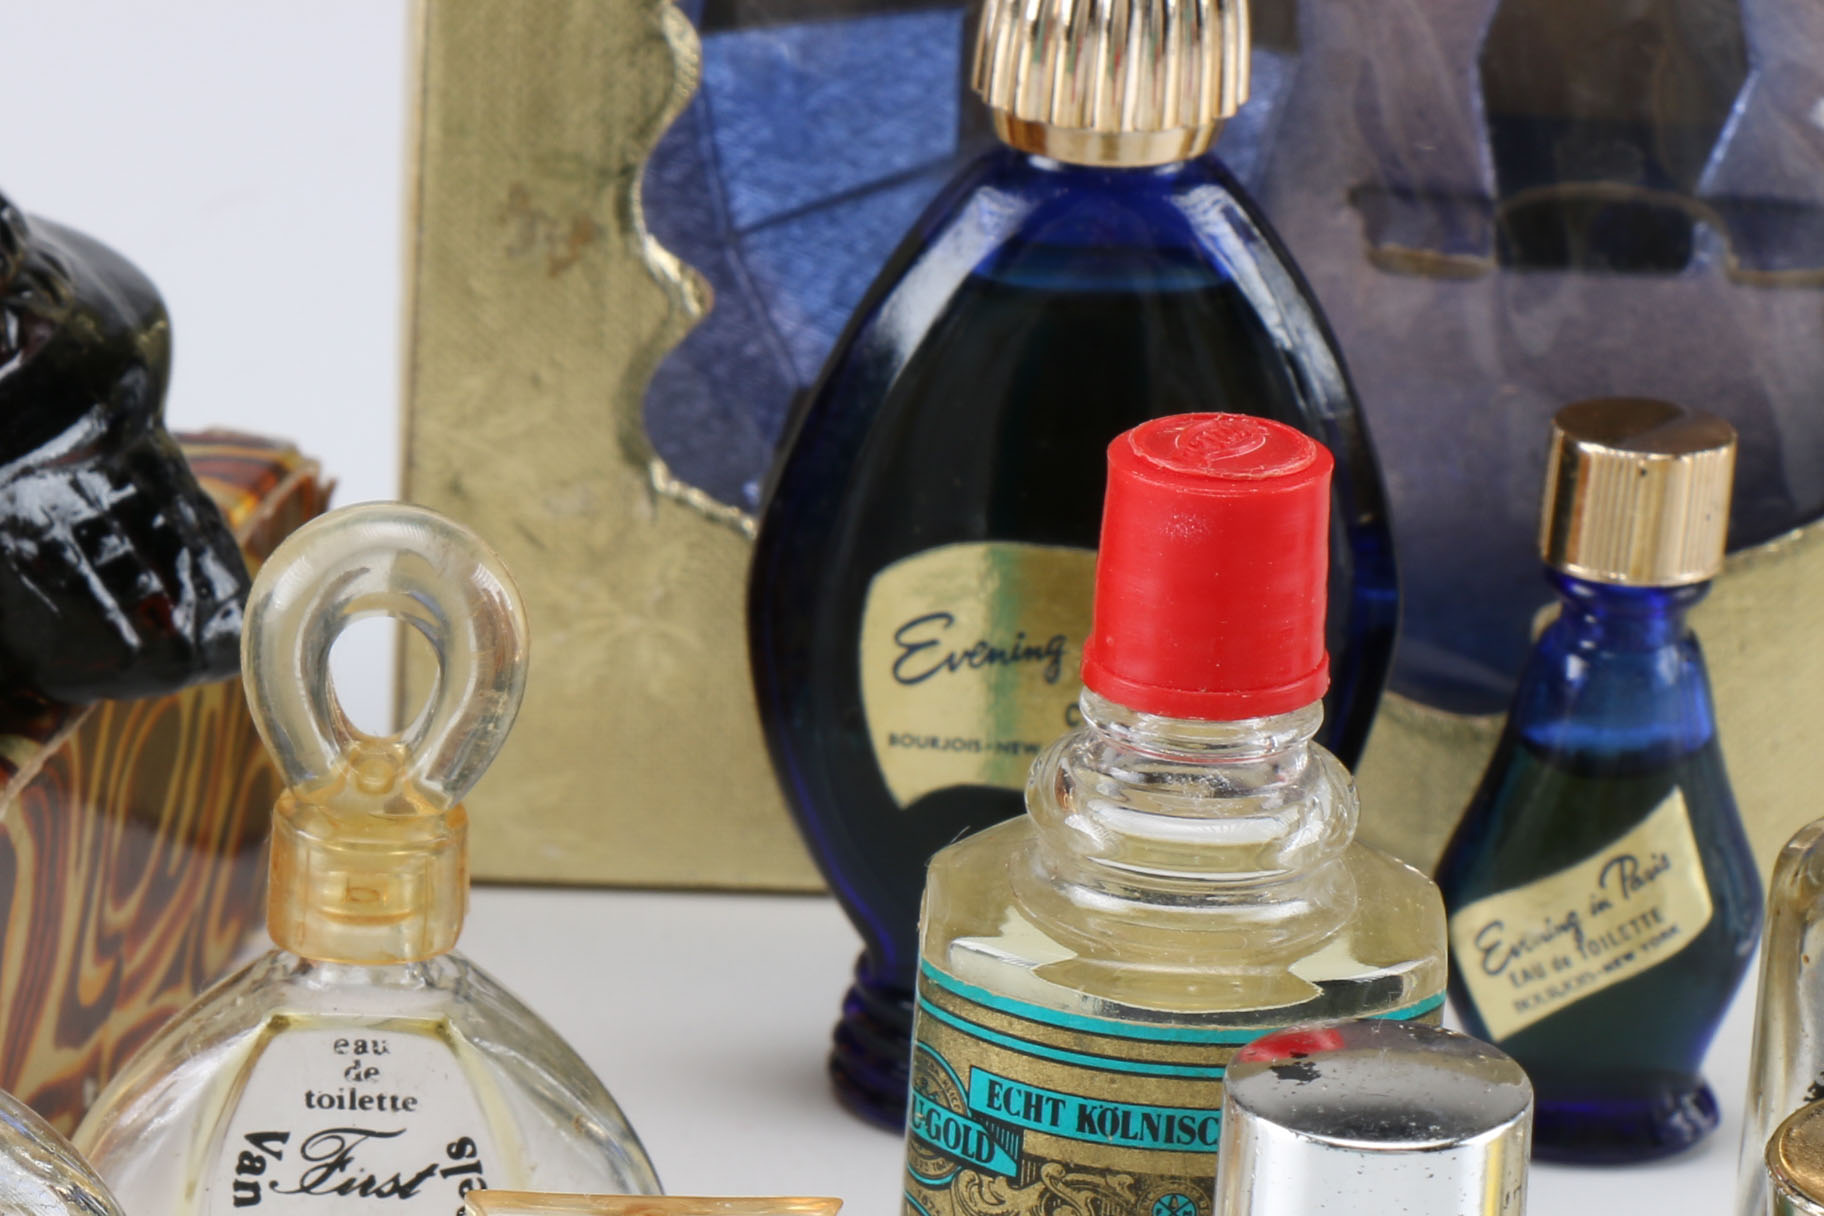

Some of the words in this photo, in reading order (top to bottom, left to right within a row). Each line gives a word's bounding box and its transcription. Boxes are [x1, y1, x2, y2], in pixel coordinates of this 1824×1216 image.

[891, 611, 1068, 686] Evening
[1474, 910, 1588, 977] Evening
[1597, 852, 1672, 901] Paris
[1580, 906, 1665, 957] TOILETTE
[332, 1037, 392, 1056] eau
[343, 1059, 381, 1083] de
[303, 1088, 419, 1113] toilette
[985, 1078, 1067, 1128] ECHT
[232, 1130, 291, 1208] Van
[268, 1127, 440, 1201] First
